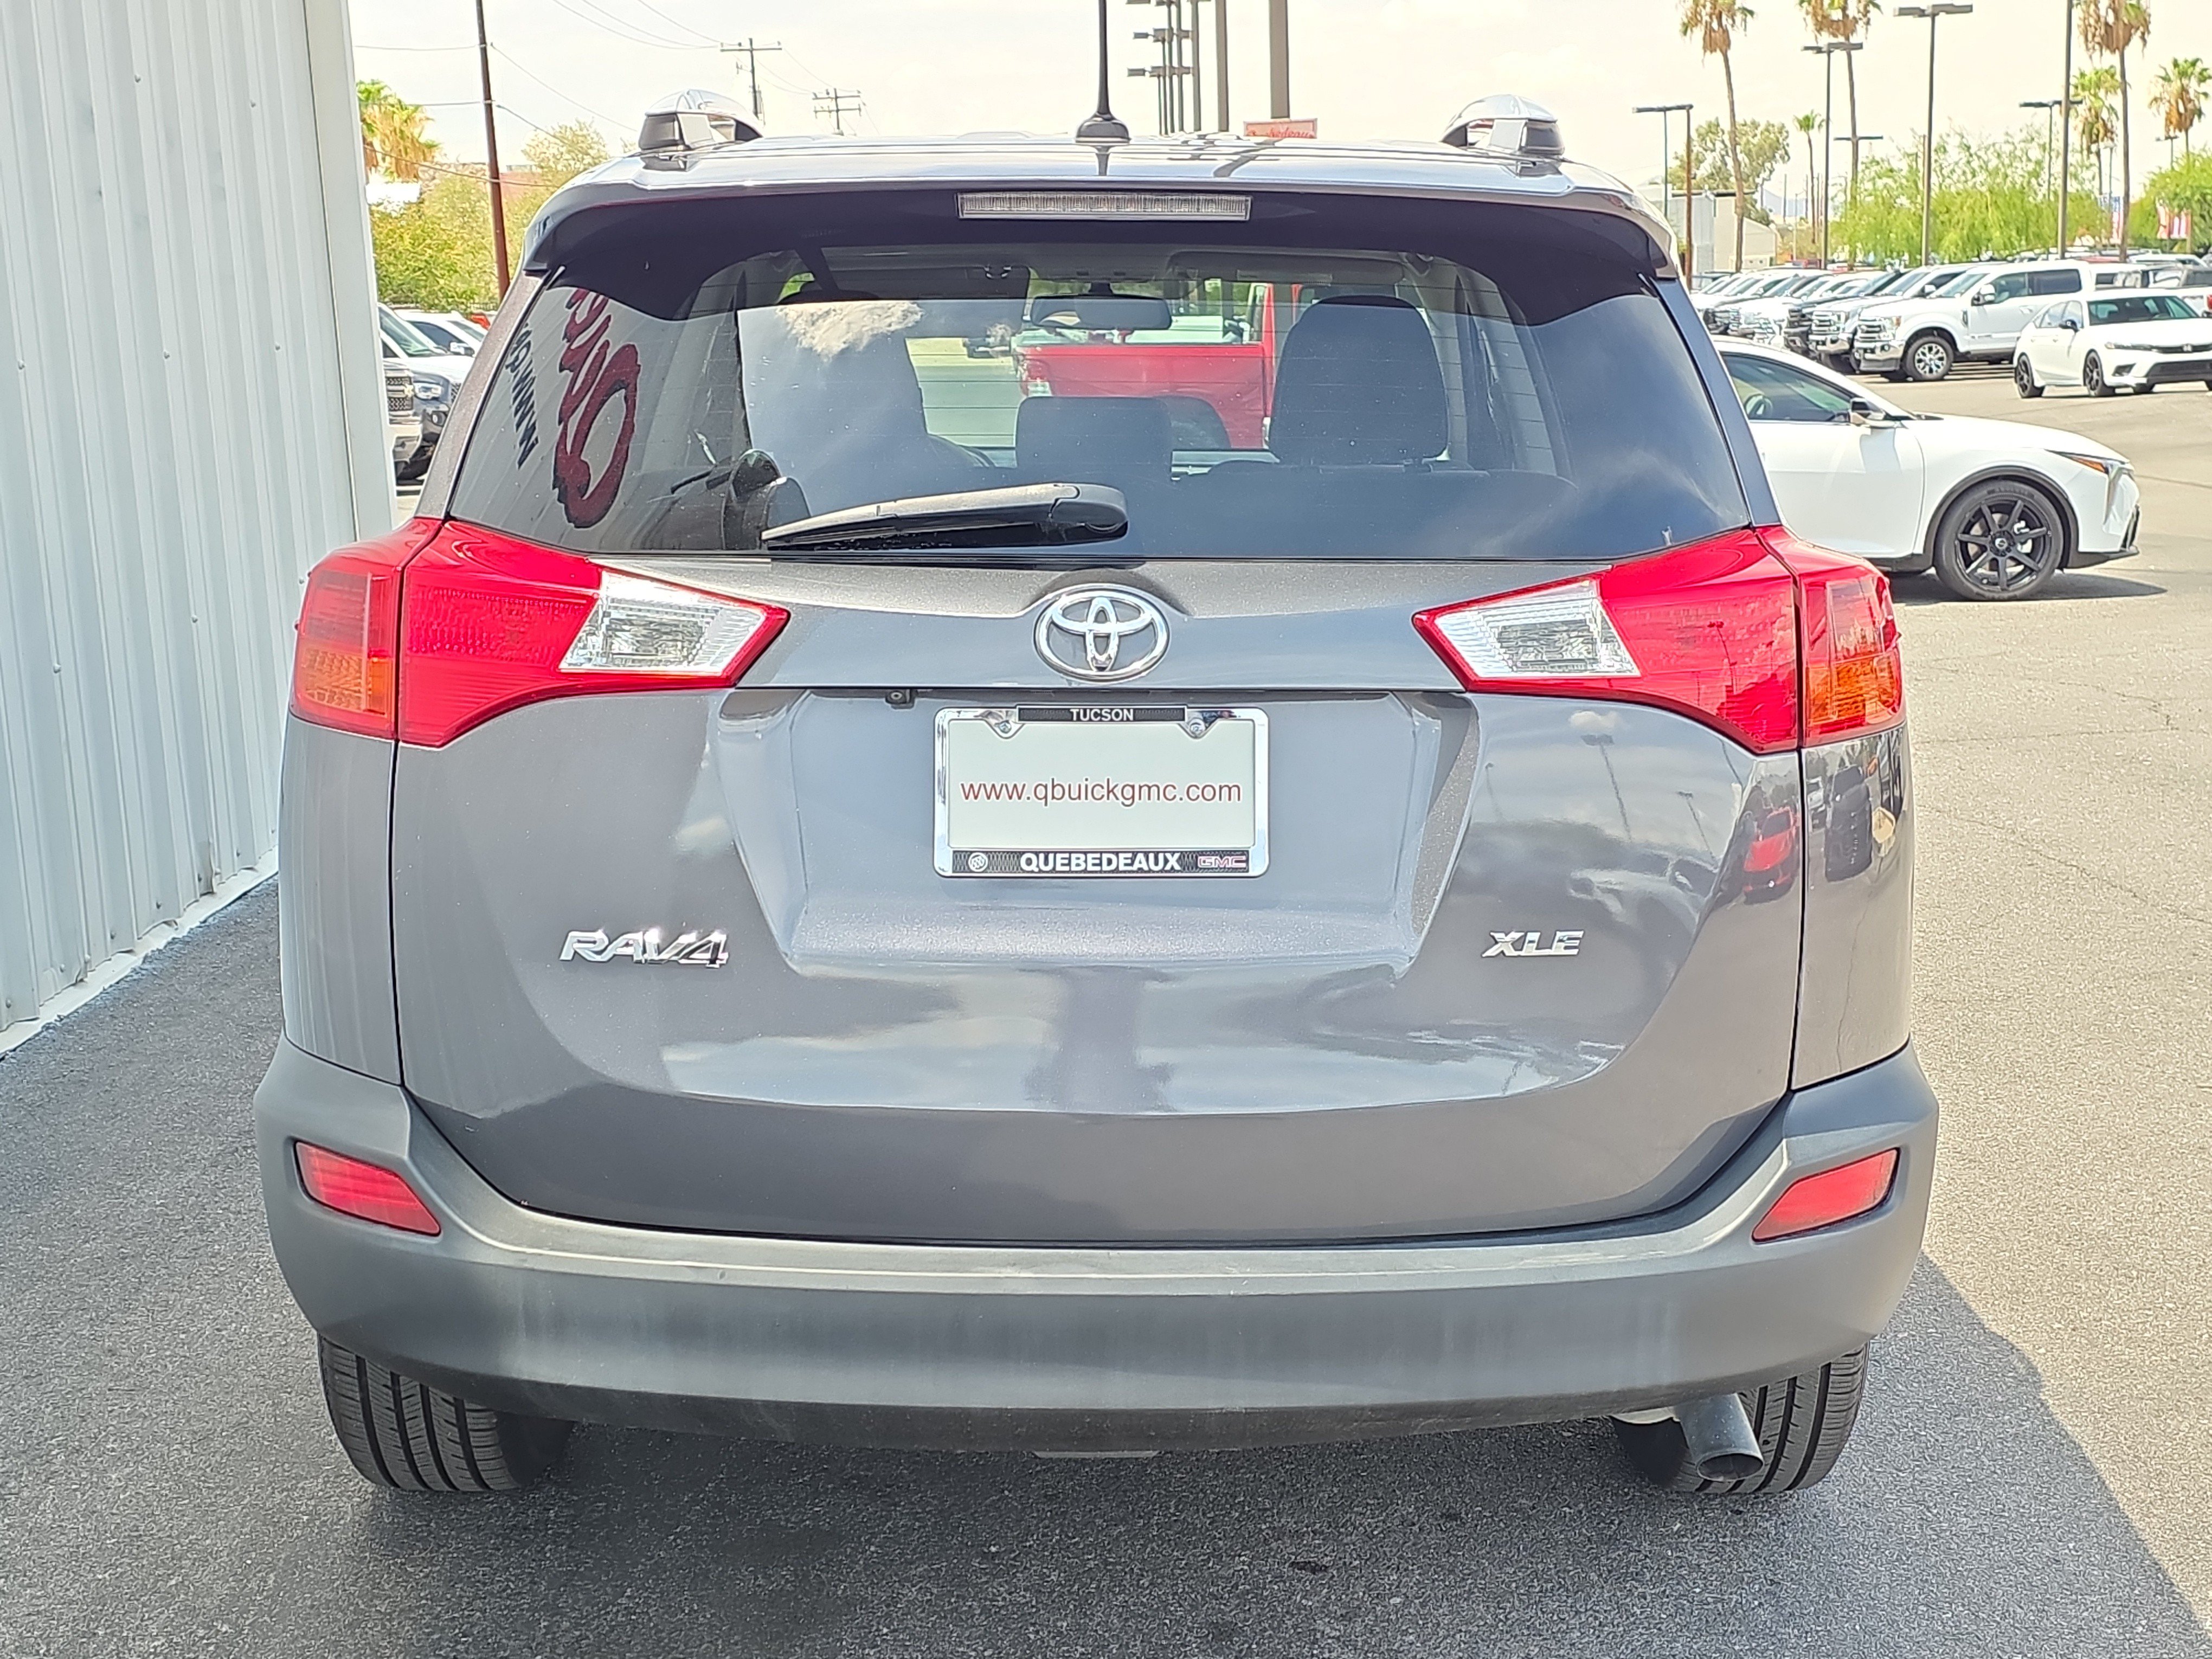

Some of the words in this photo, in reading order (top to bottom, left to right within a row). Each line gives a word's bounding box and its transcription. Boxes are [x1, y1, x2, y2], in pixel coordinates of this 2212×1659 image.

[1070, 708, 1134, 722] TUCSON
[961, 778, 1241, 807] www.qbuickgmc.com
[1020, 852, 1181, 872] QUEBEDEAUX
[1197, 855, 1247, 869] GMC
[560, 928, 729, 968] RAV4
[1481, 930, 1585, 957] XLE
